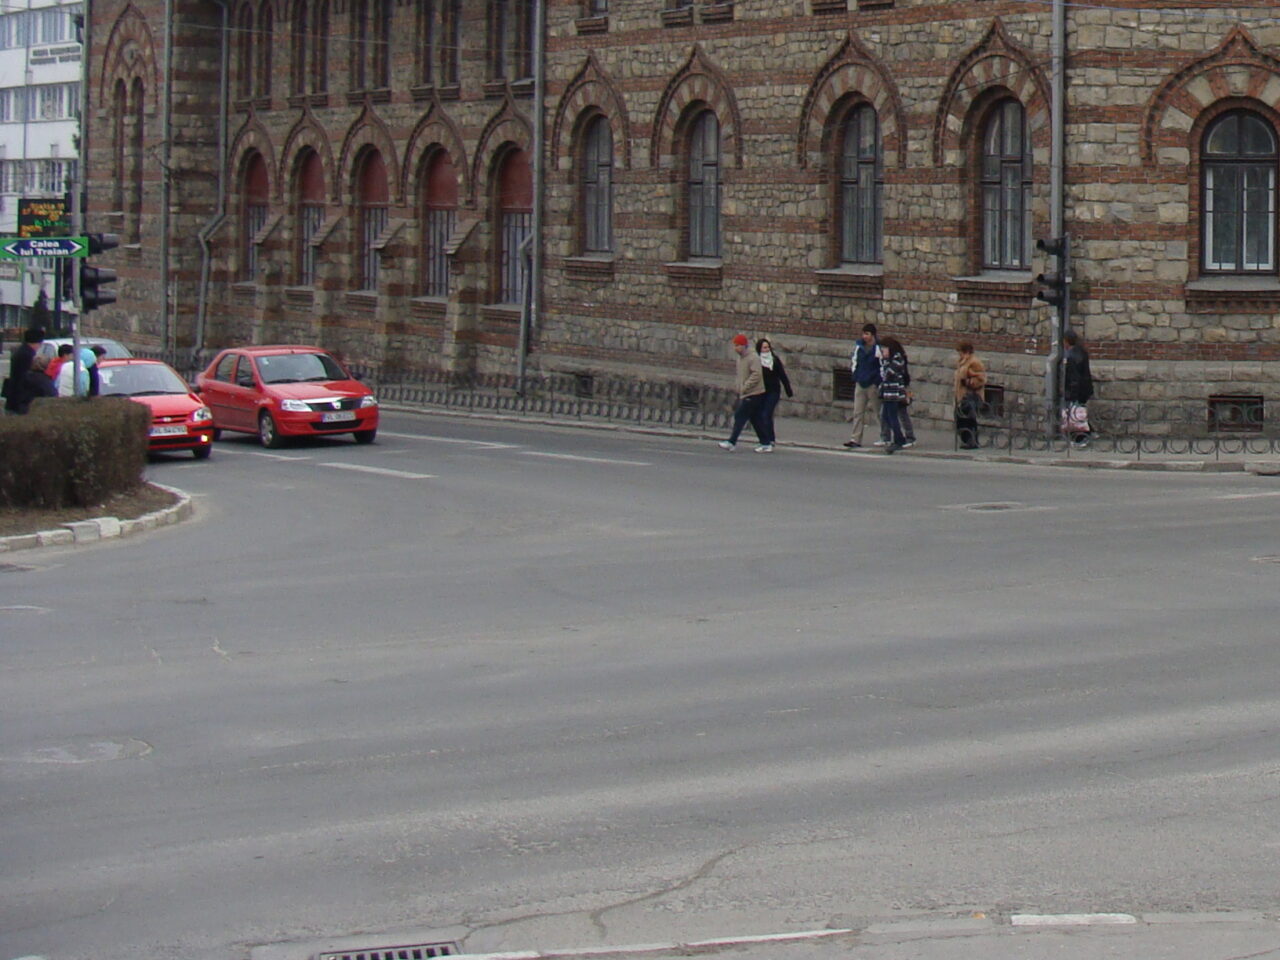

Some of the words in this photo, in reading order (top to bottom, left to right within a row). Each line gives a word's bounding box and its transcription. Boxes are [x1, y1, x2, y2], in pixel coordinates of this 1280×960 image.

[30, 240, 59, 248] Calea
[20, 248, 33, 256] lui
[36, 248, 69, 256] Traian
